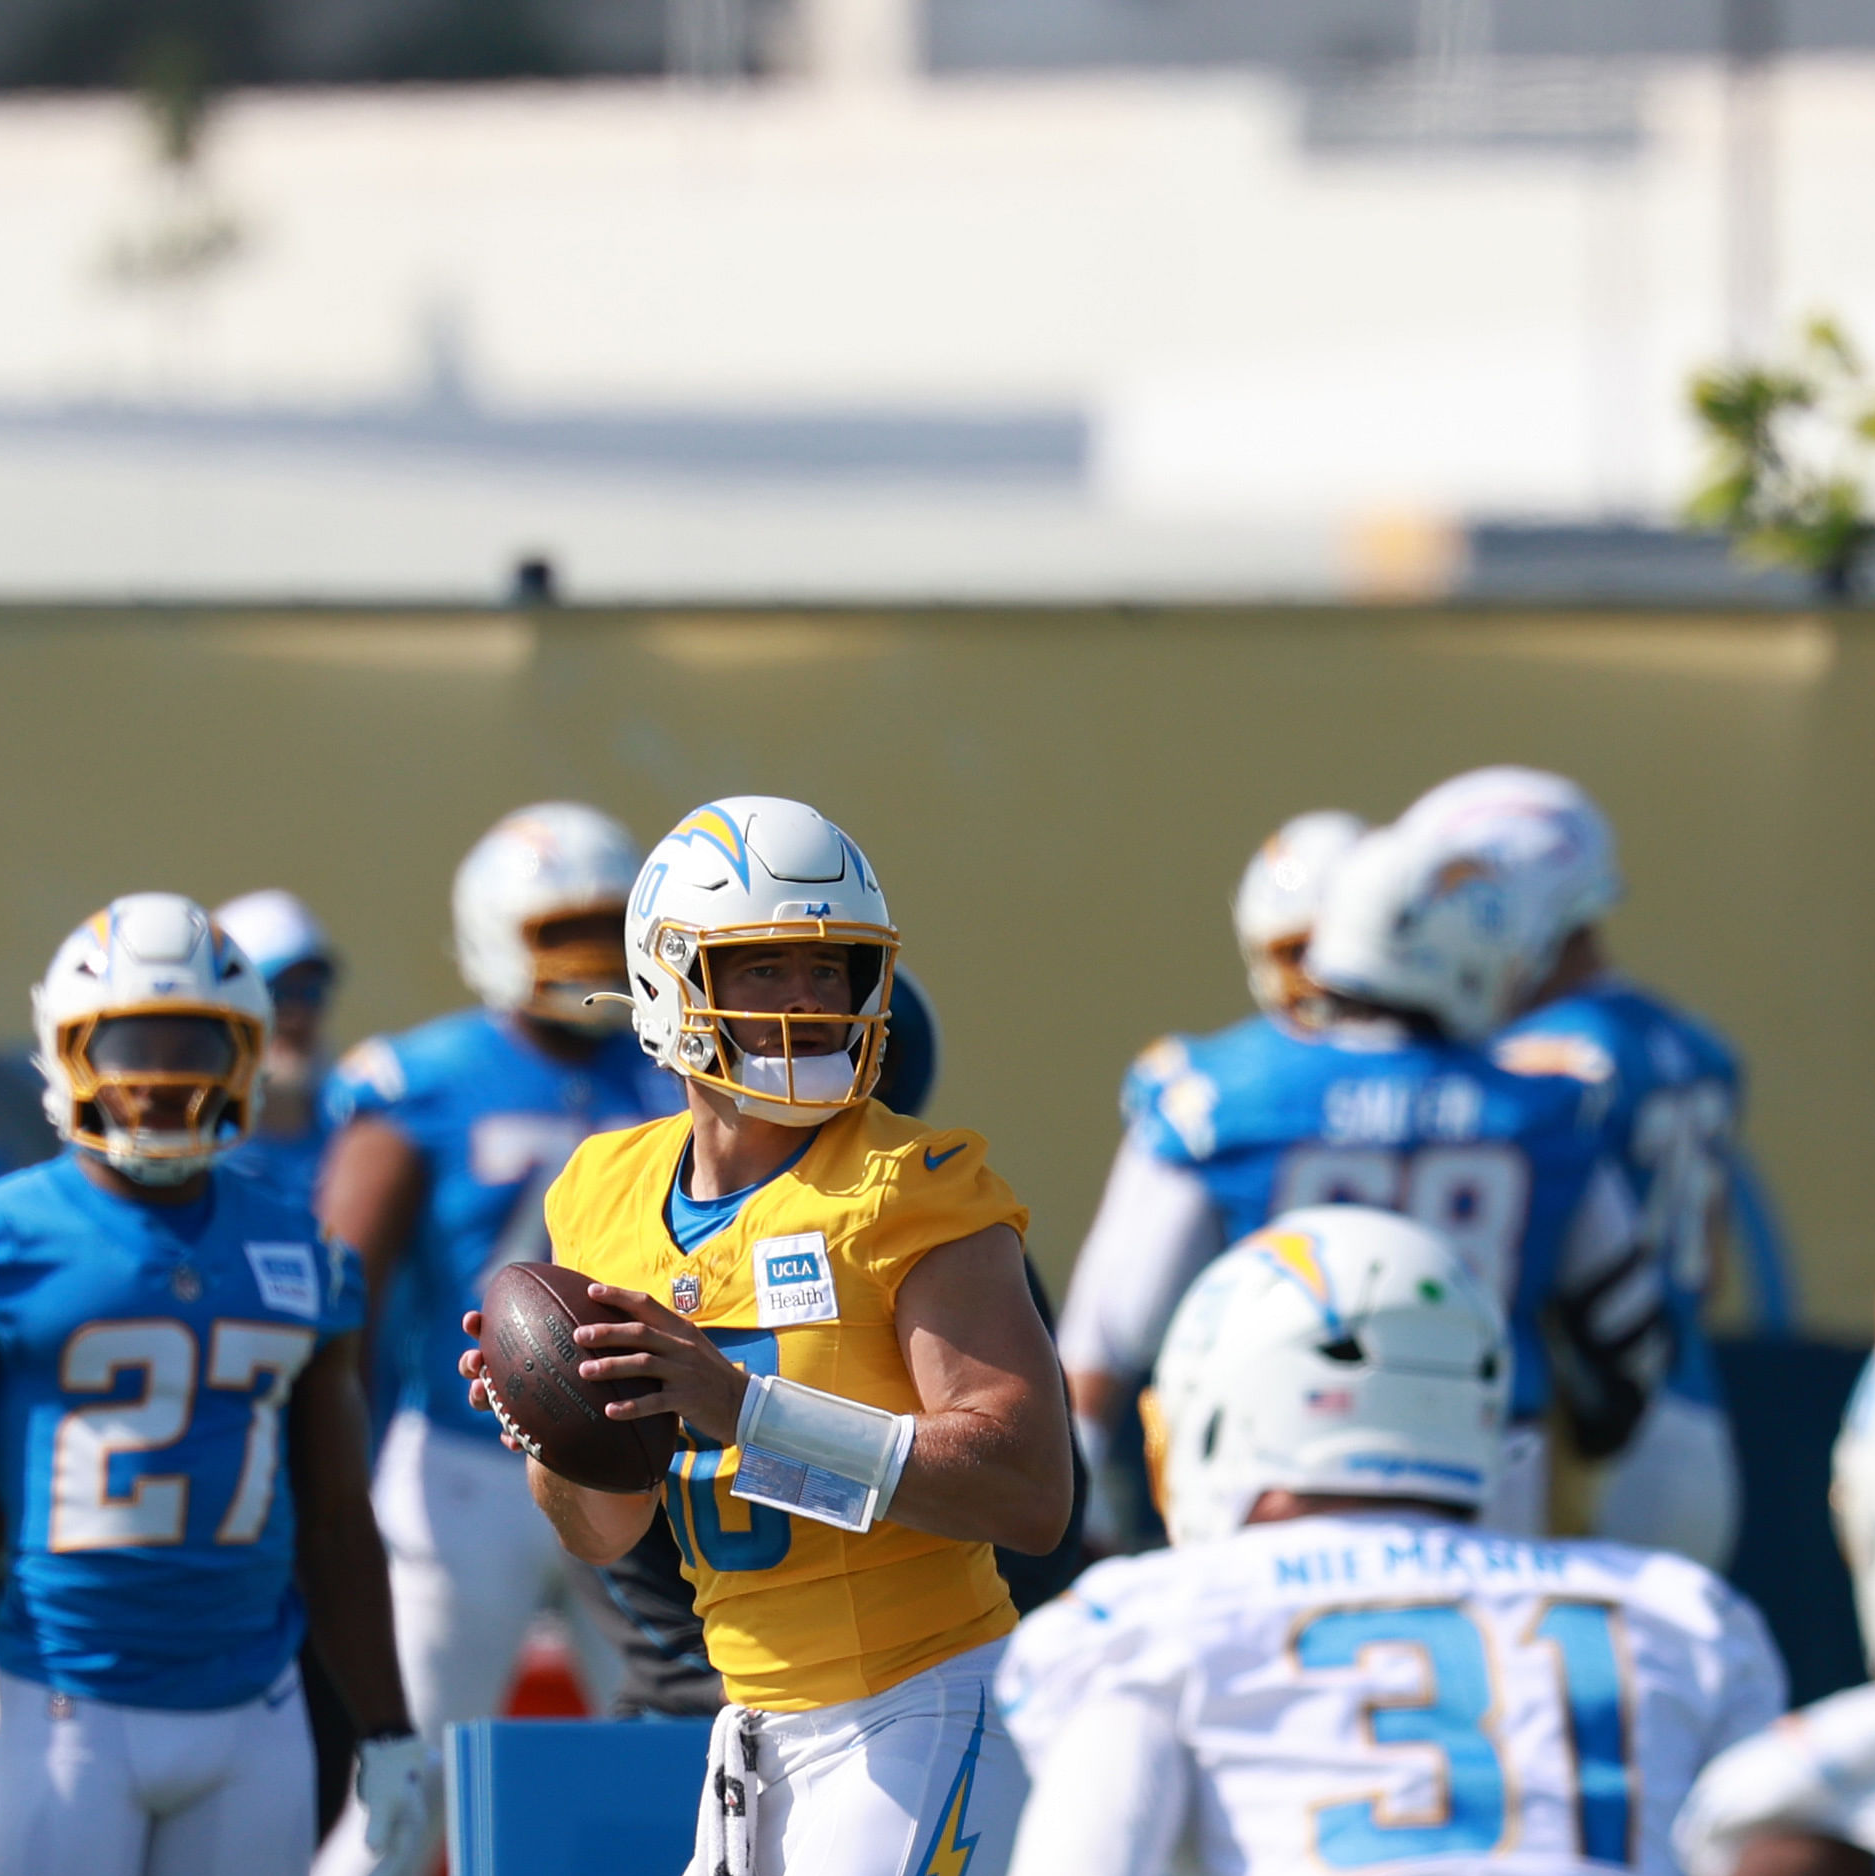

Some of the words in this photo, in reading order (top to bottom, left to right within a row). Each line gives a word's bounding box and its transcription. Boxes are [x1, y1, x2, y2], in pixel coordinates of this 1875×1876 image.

[771, 1259, 813, 1279] UCLA
[770, 1288, 824, 1310] Health
[48, 1316, 316, 1553] 27
